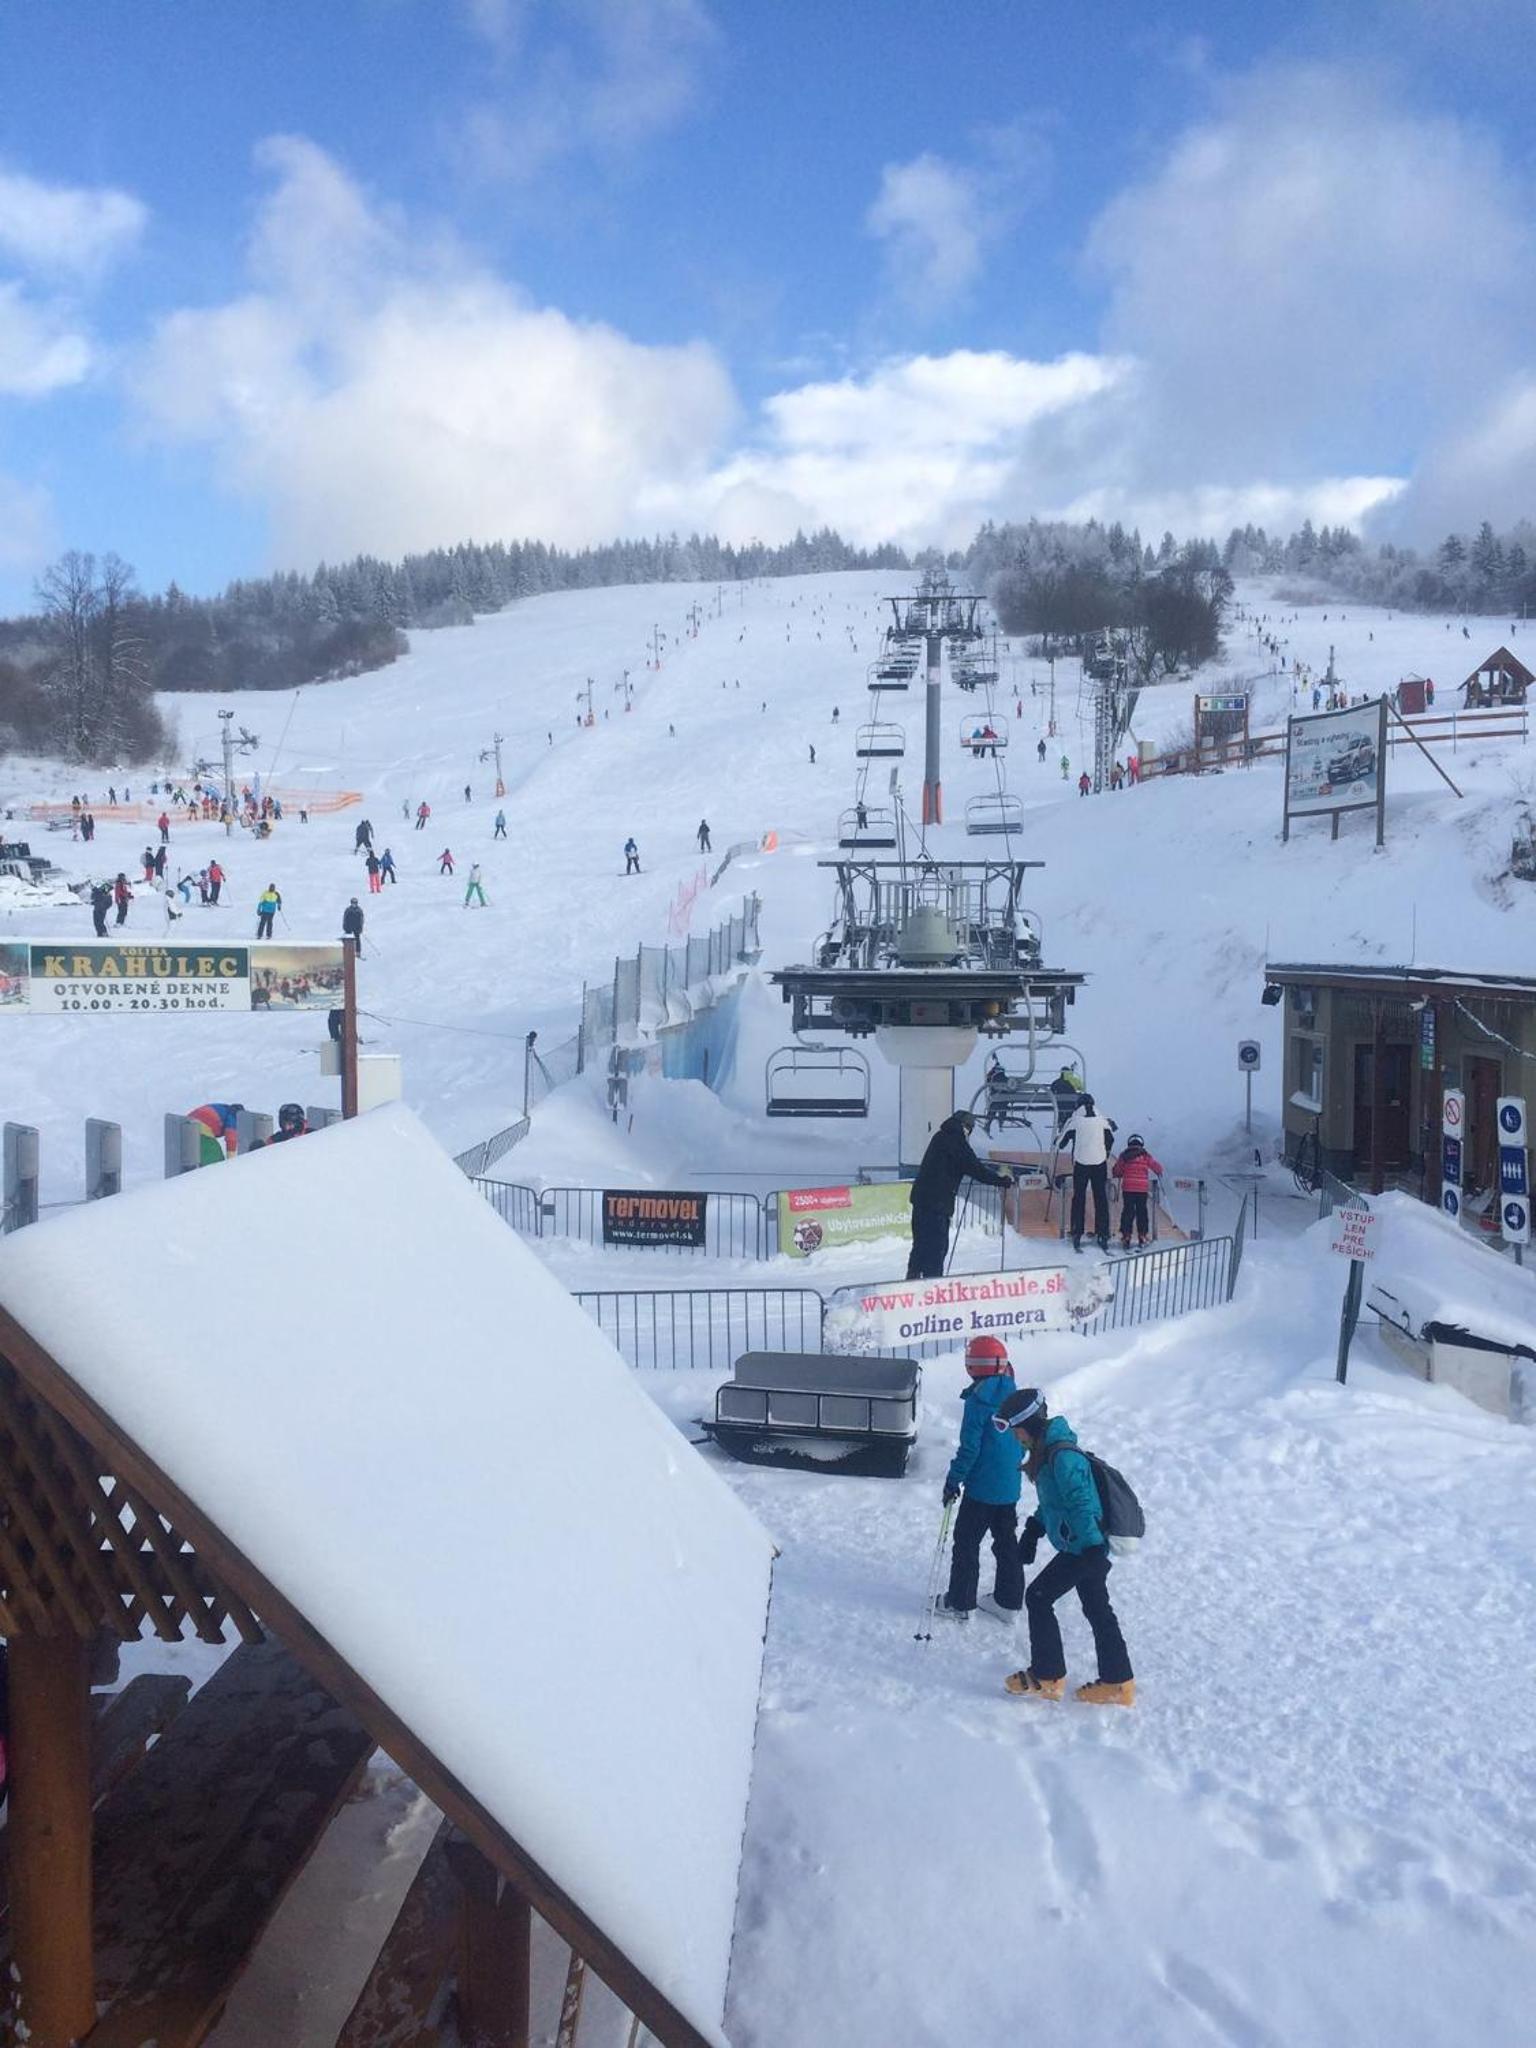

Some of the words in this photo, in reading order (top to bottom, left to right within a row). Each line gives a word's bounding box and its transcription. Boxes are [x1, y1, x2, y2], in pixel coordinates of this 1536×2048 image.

[119, 947, 168, 956] KOLIBA
[54, 981, 161, 996] OTVORENÉ
[166, 982, 230, 995] DENNE
[61, 999, 112, 1010] 10.00
[130, 998, 180, 1010] 20.30
[186, 997, 225, 1009] hod.
[1339, 1210, 1376, 1225] VSTUP
[612, 1230, 694, 1241] www.termovel.sk
[1344, 1223, 1366, 1235] LEN
[1343, 1234, 1365, 1247] PRE
[860, 1273, 1068, 1313] www.skikrahule.sk
[899, 1315, 964, 1338] online
[971, 1306, 1046, 1330] kamera
